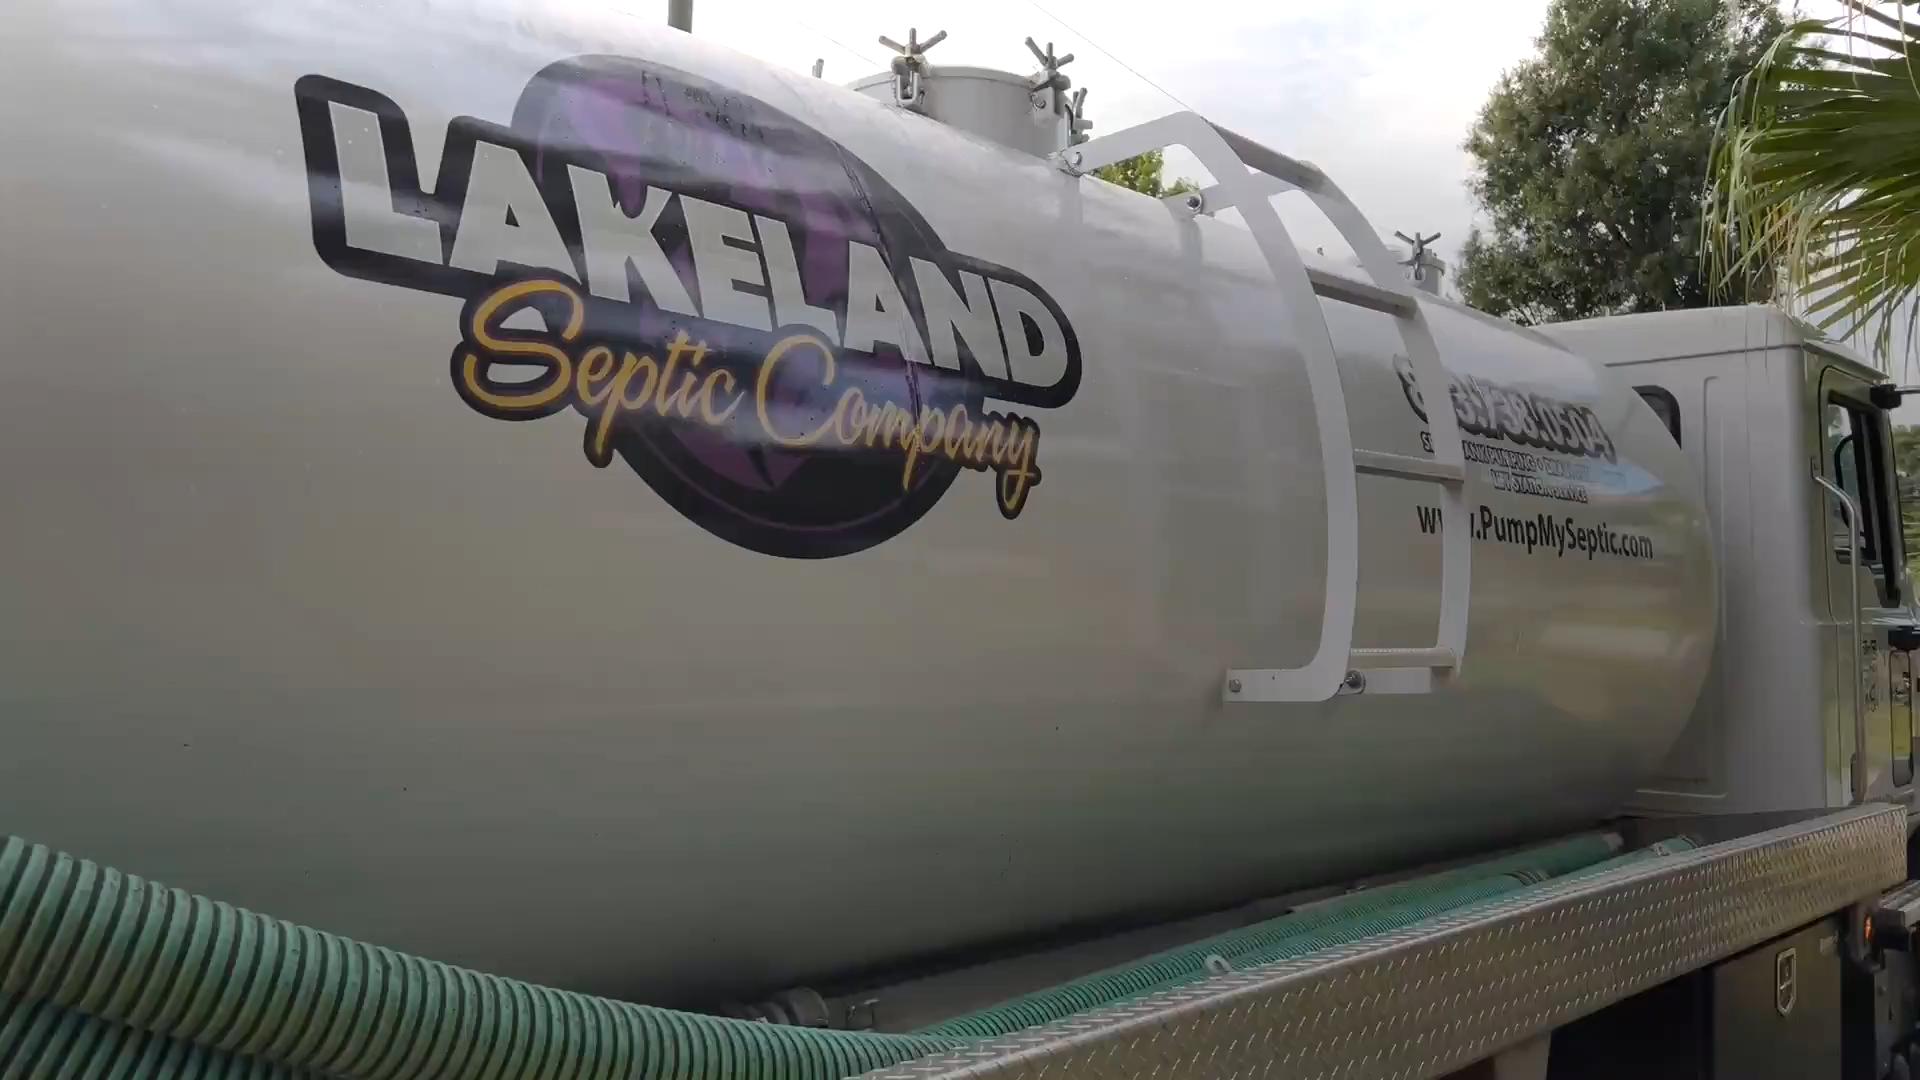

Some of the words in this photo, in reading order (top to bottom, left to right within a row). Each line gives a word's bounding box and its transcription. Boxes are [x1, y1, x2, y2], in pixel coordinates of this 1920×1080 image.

[328, 100, 1070, 389] LAKELAND
[463, 279, 737, 453] Septic
[755, 335, 1040, 510] Company
[1393, 353, 1616, 464] 83.738.0504
[1416, 504, 1654, 560] w.PumpMySeptic.com
